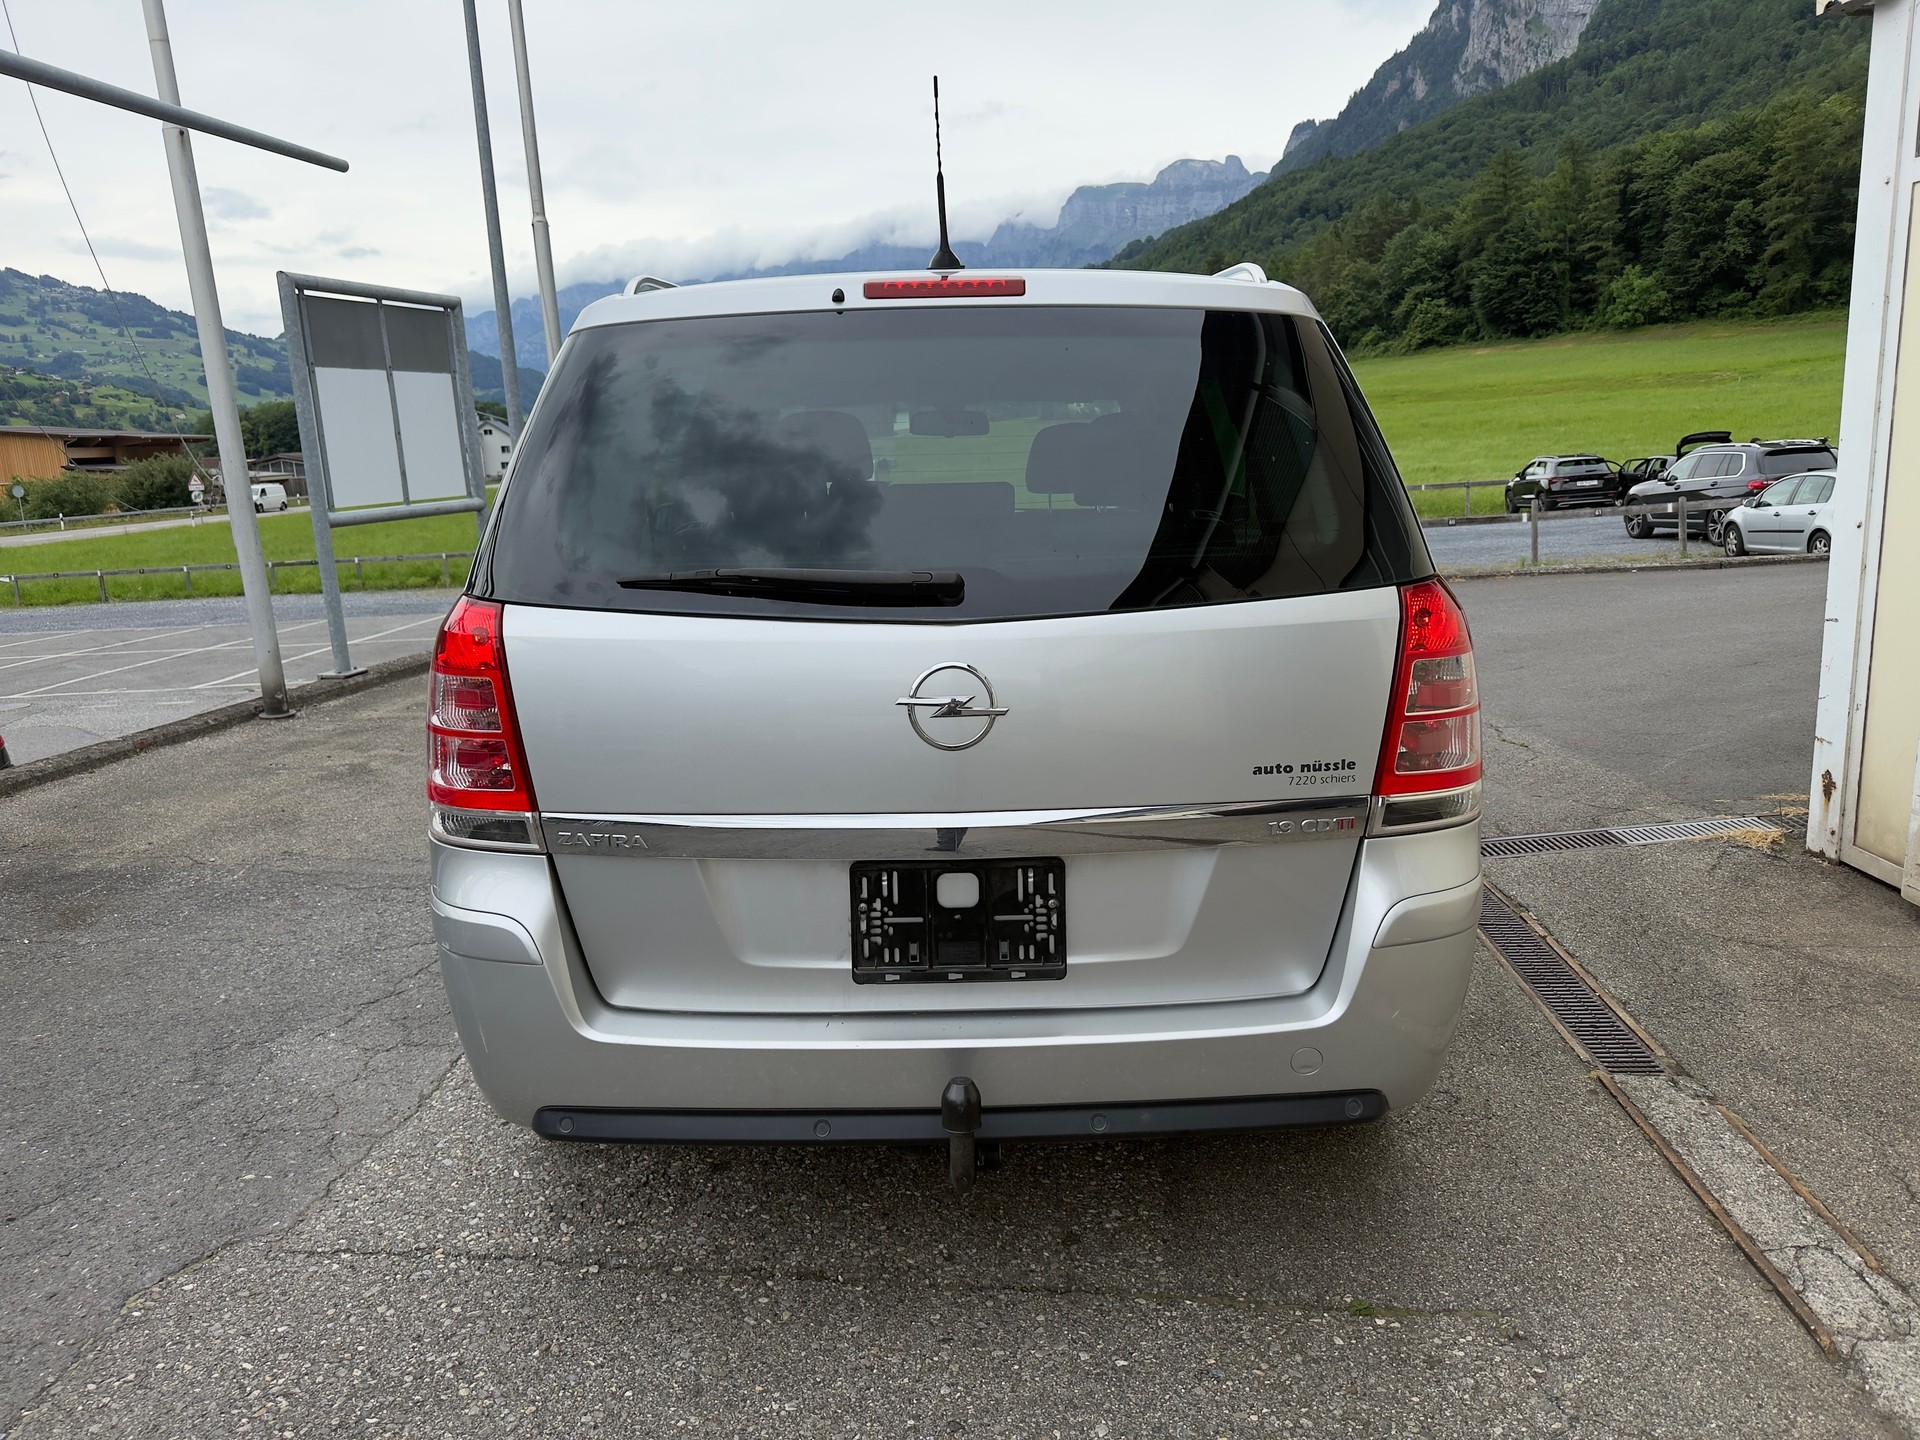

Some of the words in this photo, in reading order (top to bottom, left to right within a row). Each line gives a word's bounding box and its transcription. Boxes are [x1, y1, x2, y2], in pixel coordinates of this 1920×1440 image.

[1253, 763, 1294, 775] auto
[1300, 759, 1357, 773] nüssle
[1288, 775, 1317, 786] 7220
[1320, 773, 1356, 785] schiers
[557, 831, 649, 849] ZAFIRA
